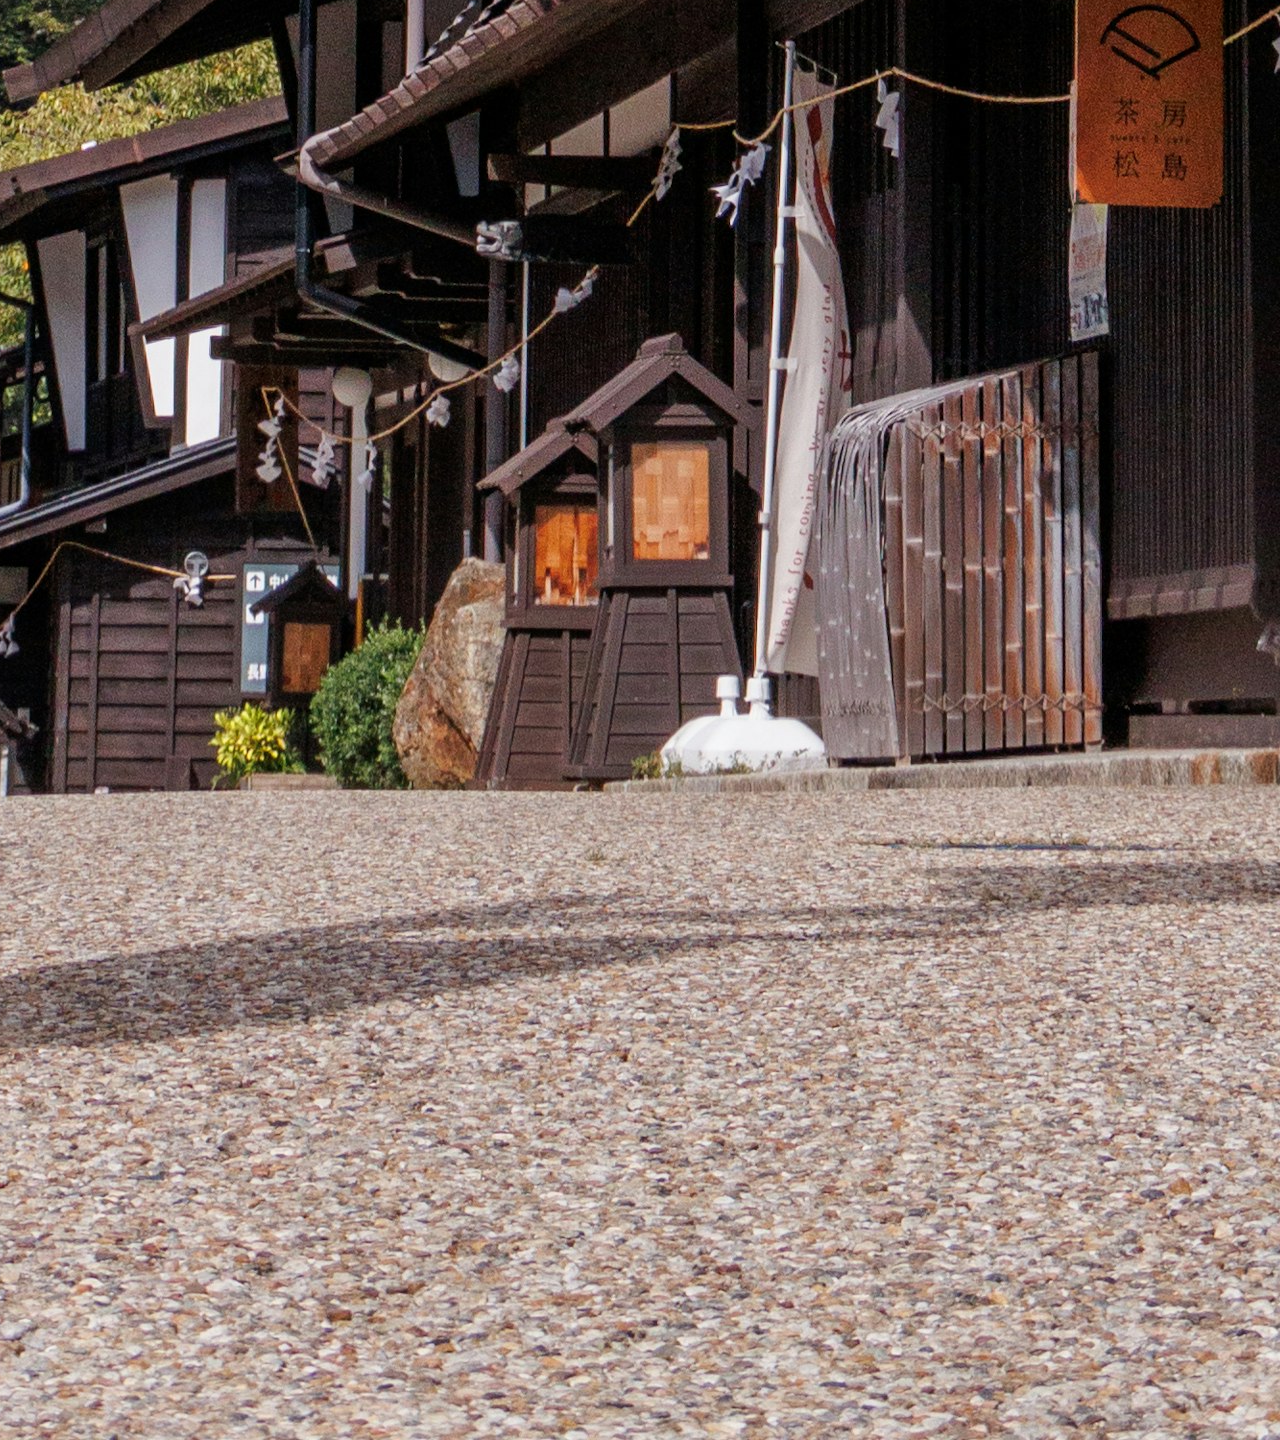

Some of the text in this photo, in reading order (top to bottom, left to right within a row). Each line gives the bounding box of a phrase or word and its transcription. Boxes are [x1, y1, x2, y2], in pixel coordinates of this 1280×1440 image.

[1112, 95, 1189, 128] 茶房
[1111, 150, 1189, 183] 松島
[773, 587, 800, 647] Thanks
[787, 548, 805, 575] for
[820, 335, 833, 374] very
